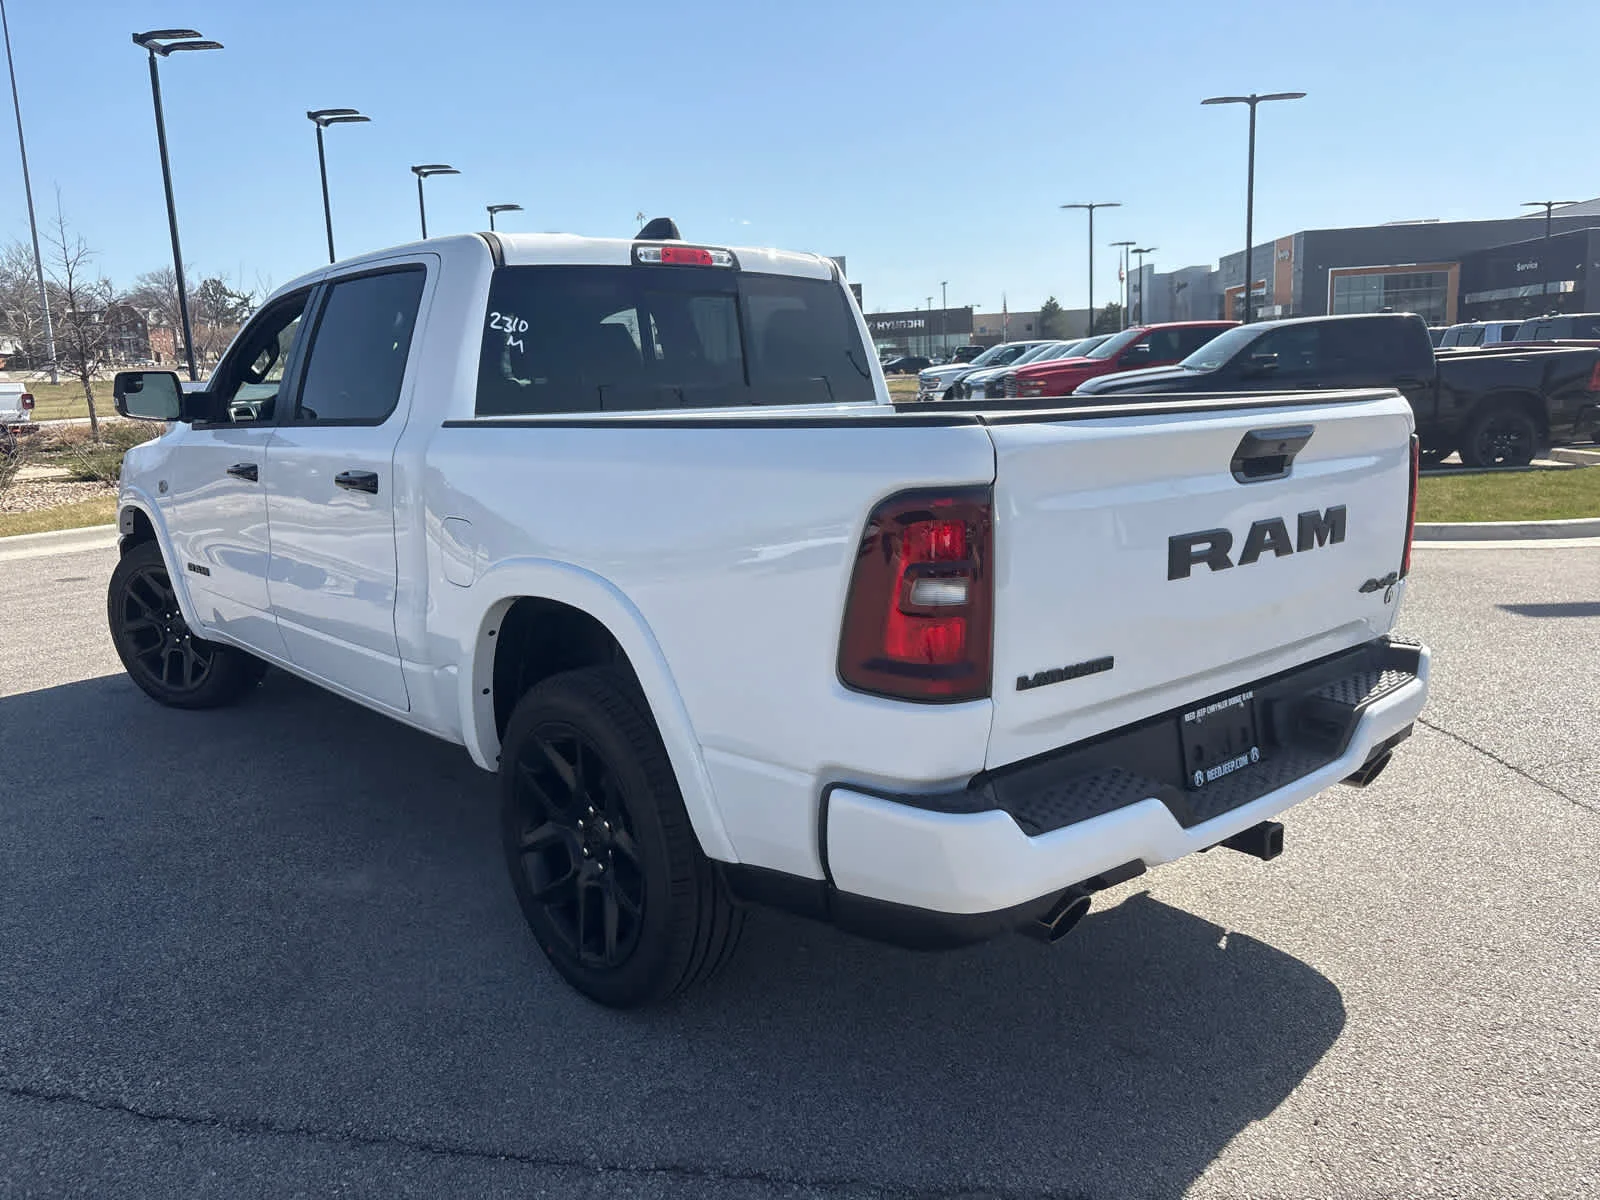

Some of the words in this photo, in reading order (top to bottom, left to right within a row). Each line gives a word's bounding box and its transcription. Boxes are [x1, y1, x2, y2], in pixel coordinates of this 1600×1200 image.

[1515, 261, 1538, 272] Service
[490, 311, 529, 333] 2310
[1167, 503, 1347, 581] RAM
